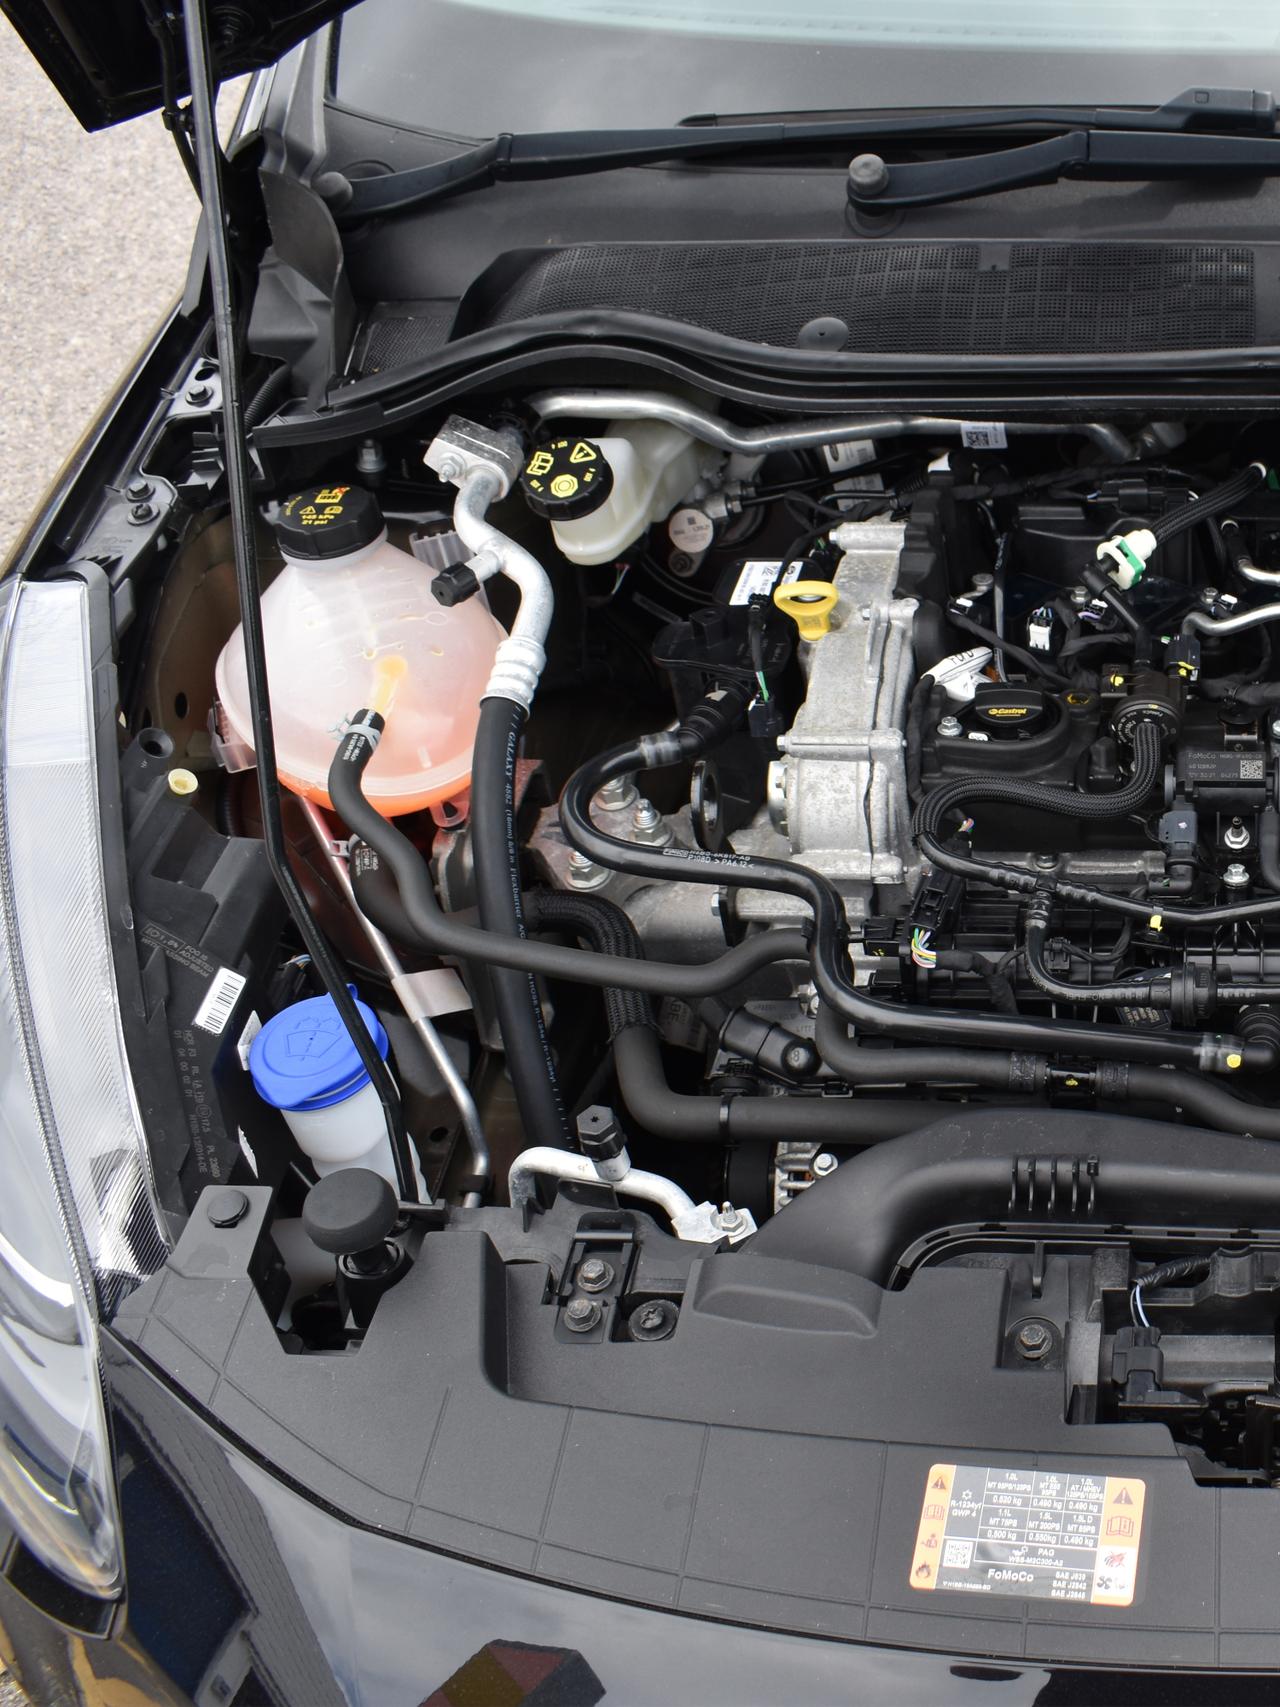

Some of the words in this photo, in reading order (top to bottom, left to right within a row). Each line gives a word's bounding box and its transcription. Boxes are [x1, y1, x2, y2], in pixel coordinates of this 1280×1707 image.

[506, 731, 517, 780] GALAXY
[950, 1500, 983, 1510] R-1234yf
[1012, 1496, 1023, 1506] kg
[1053, 1500, 1063, 1510] kg
[1088, 1502, 1099, 1512] kg
[952, 1509, 971, 1517] GWP
[1007, 1531, 1017, 1541] kg
[1084, 1536, 1094, 1547] kg
[1038, 1548, 1055, 1557] PAG
[987, 1568, 1034, 1582] FoMoCo
[1055, 1571, 1070, 1580] SAE
[1052, 1580, 1066, 1588] SAE
[1051, 1589, 1065, 1597] SAE
